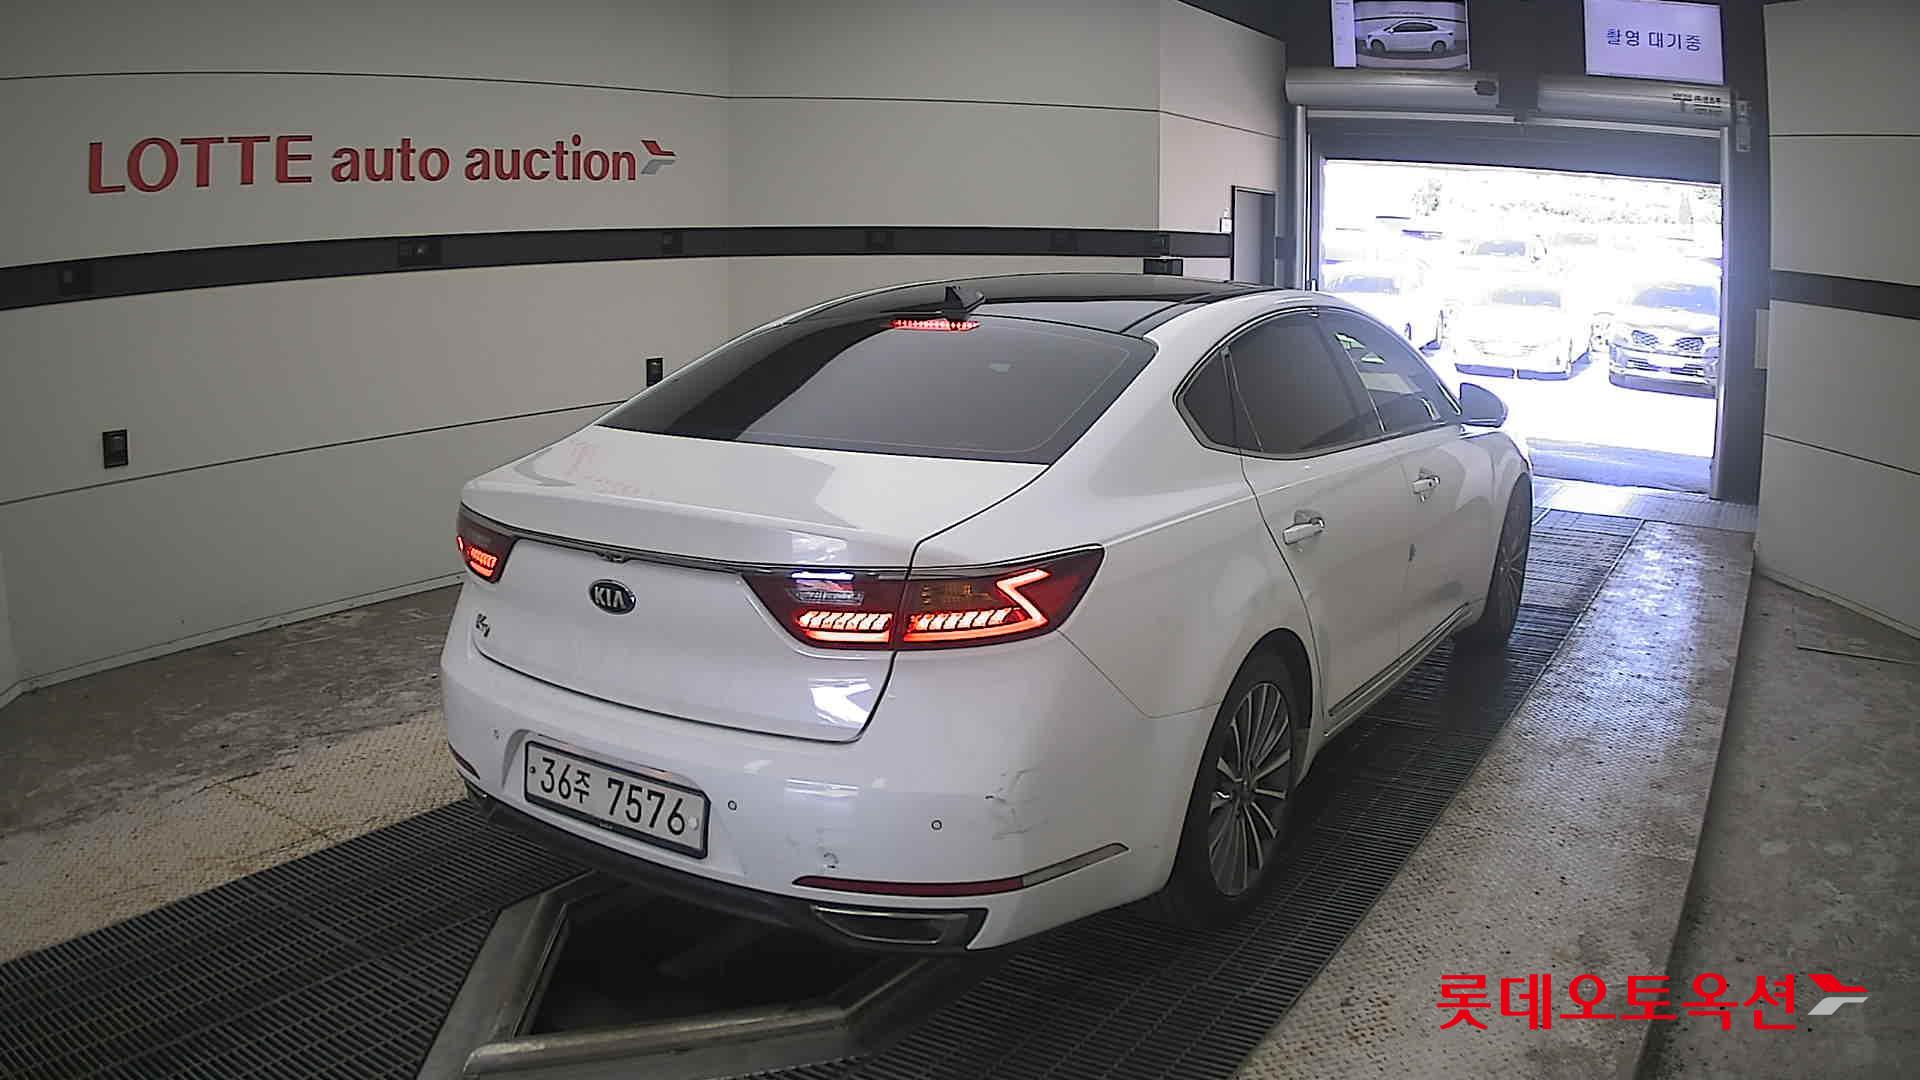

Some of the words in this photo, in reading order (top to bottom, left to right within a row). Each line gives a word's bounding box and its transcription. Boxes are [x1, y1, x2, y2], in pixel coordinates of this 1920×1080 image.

[1648, 31, 1702, 52] 대기중
[88, 134, 313, 194] LOTTE
[330, 137, 450, 183] auto
[463, 133, 637, 182] auction
[593, 585, 626, 610] KIA
[540, 756, 591, 804] 36주
[607, 777, 686, 836] 7576
